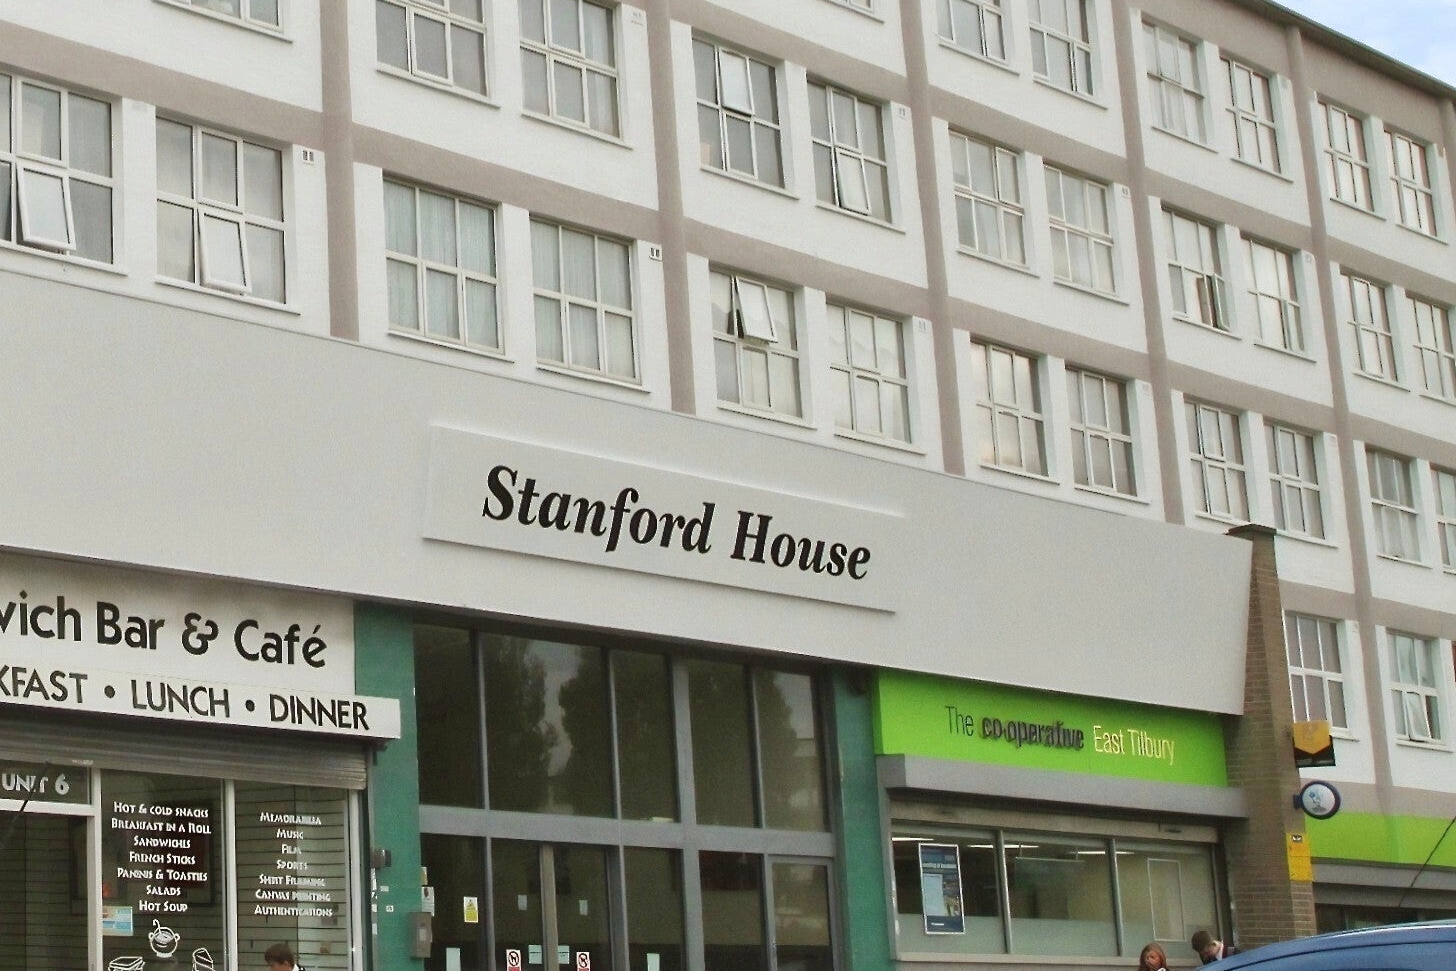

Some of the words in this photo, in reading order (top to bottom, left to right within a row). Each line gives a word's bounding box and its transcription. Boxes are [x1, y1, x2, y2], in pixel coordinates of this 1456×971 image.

[482, 465, 716, 554] Stanford
[730, 510, 871, 580] House
[96, 601, 165, 650] Bar
[181, 612, 219, 656] &
[234, 619, 327, 668] Café
[131, 679, 230, 718] LUNCH
[269, 693, 370, 731] DINNER
[945, 705, 974, 736] The
[1093, 725, 1125, 756] East
[1127, 728, 1174, 766] Tilbury
[54, 773, 70, 796] 6
[113, 801, 136, 813] HOT
[149, 806, 172, 816] COLD
[133, 835, 191, 849] SANDWICHES
[129, 851, 164, 864] FRENCH
[166, 854, 196, 865] STICKS
[146, 885, 181, 896] SALADS
[139, 900, 161, 912] HOT
[163, 900, 188, 913] SOUP
